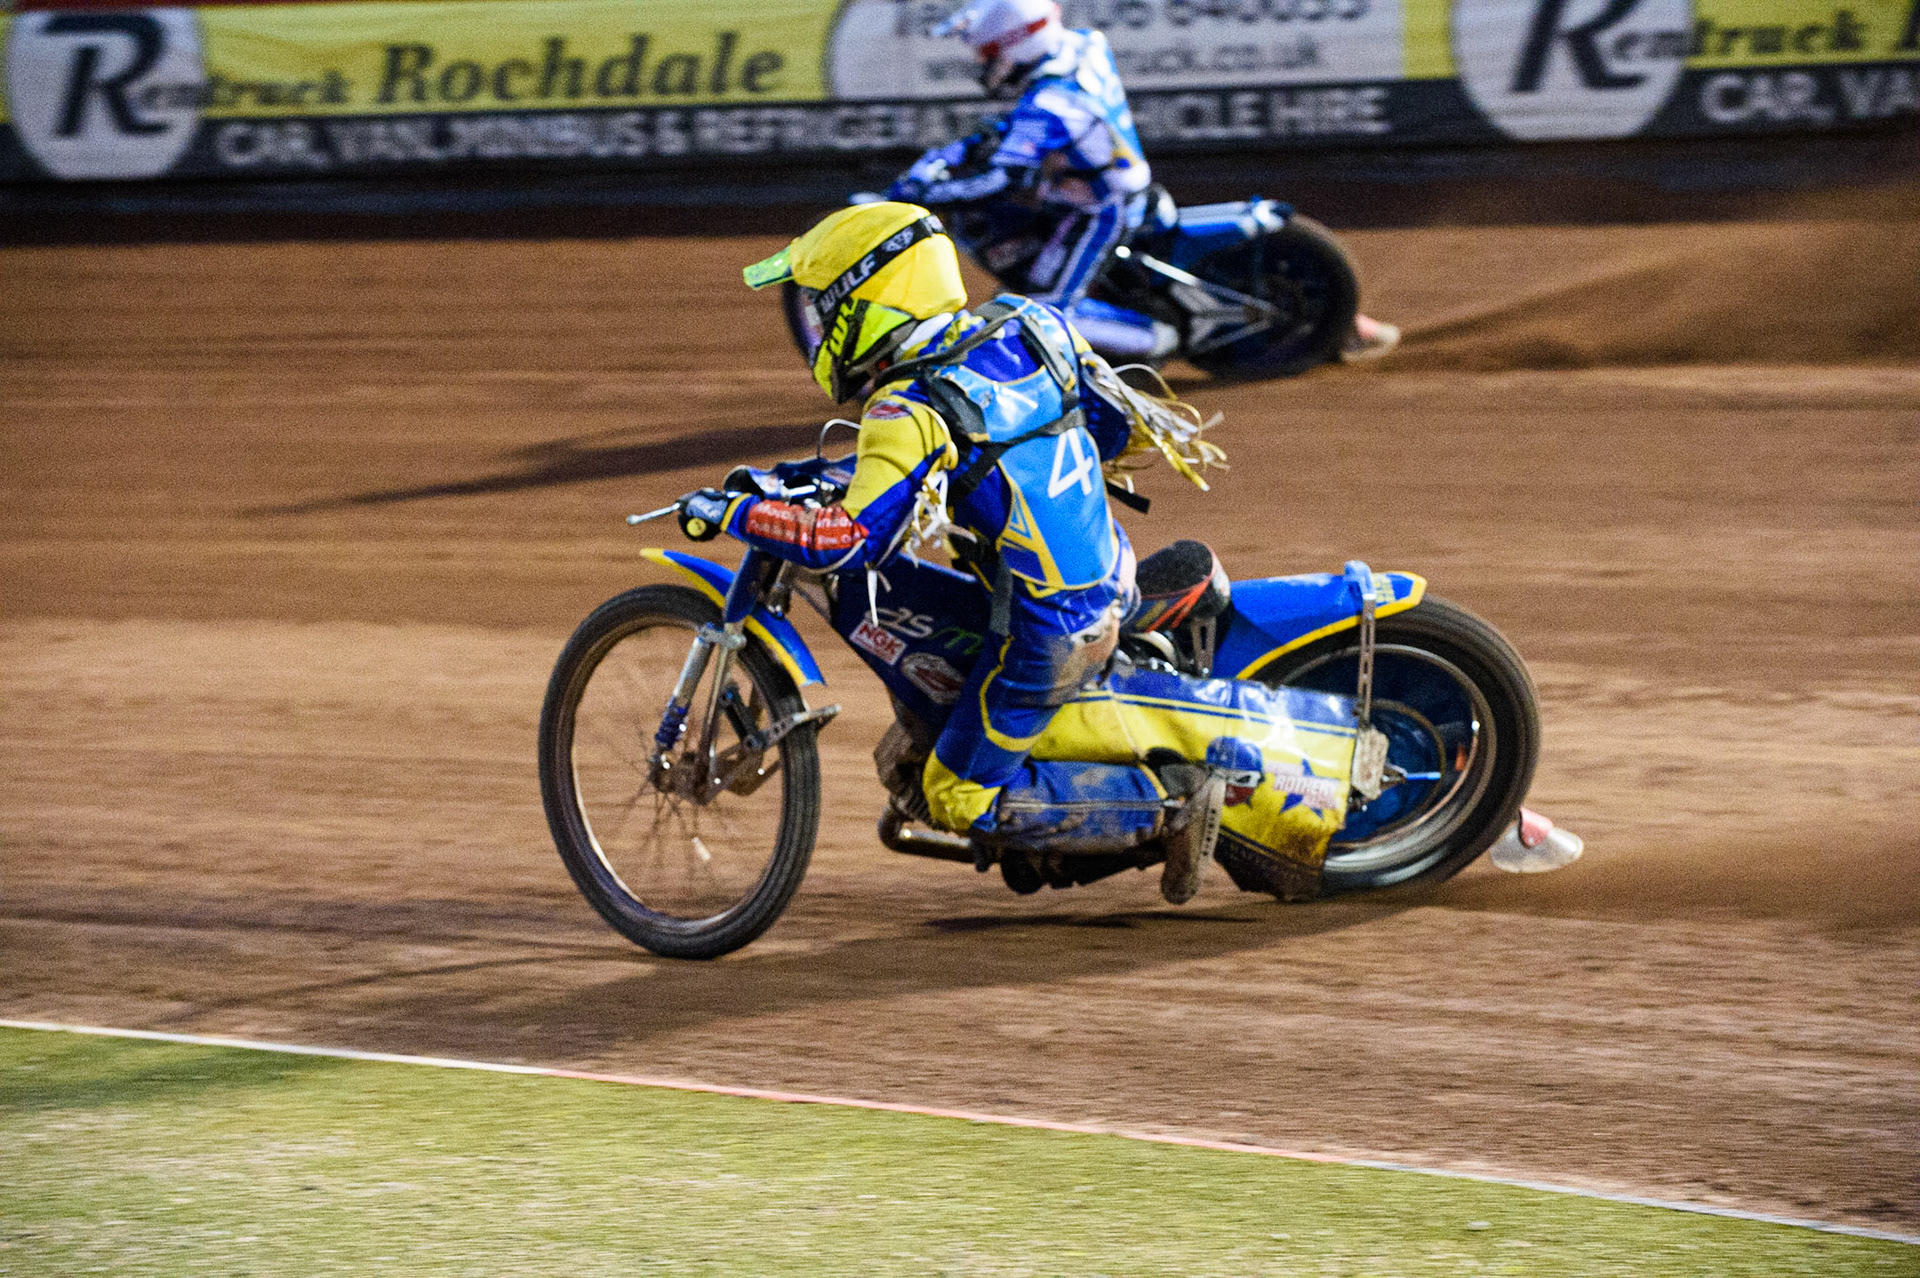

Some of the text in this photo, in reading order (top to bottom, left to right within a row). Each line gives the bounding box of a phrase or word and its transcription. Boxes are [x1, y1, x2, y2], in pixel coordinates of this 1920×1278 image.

[376, 29, 786, 104] Rochdale
[820, 252, 876, 314] WULF
[1048, 427, 1094, 499] 4
[859, 620, 904, 656] NGK
